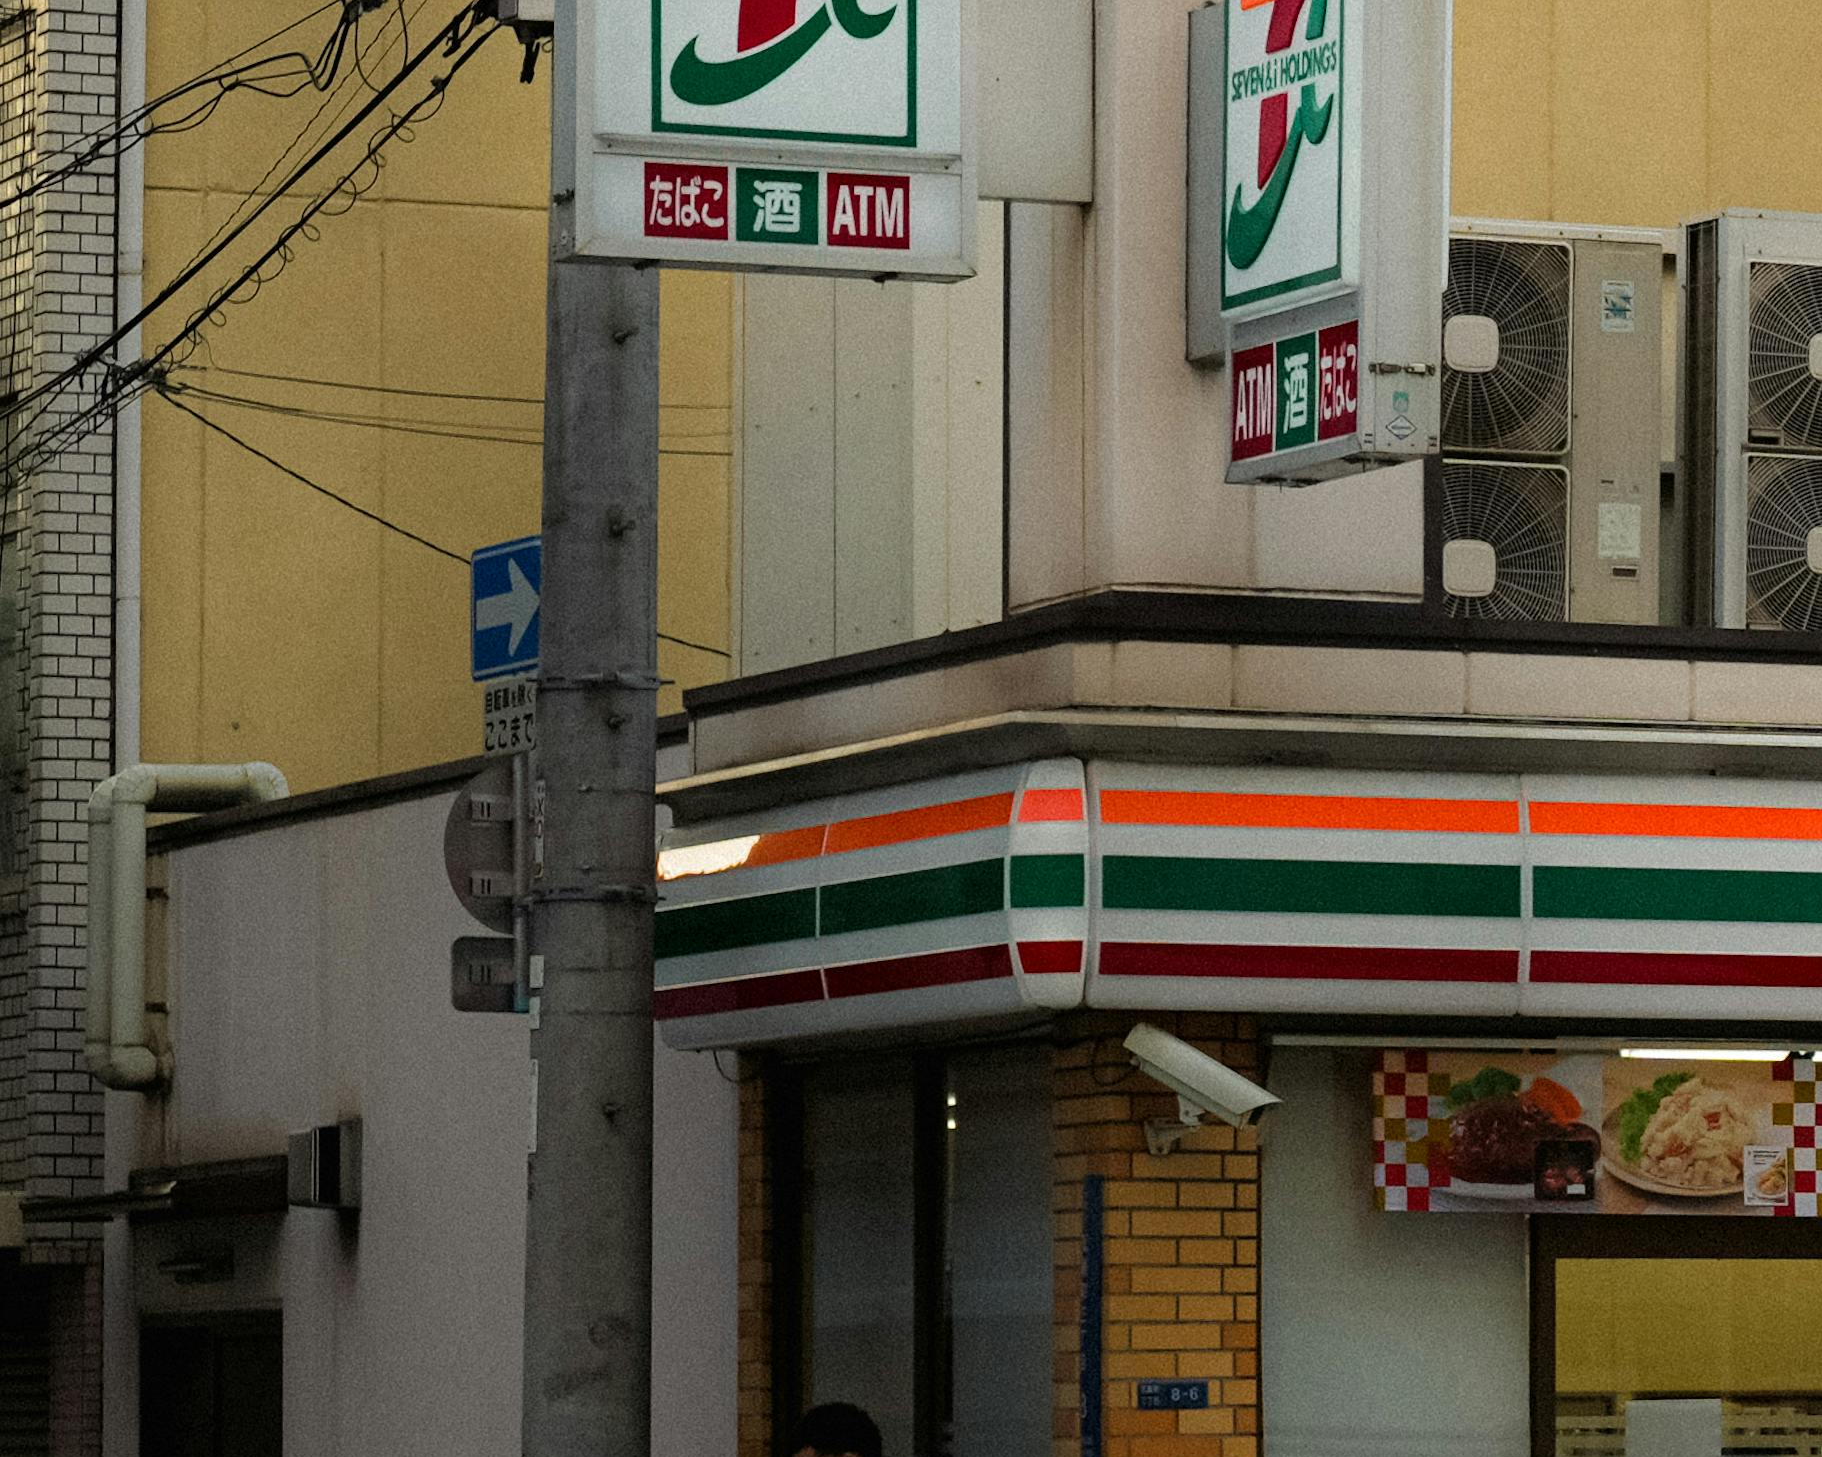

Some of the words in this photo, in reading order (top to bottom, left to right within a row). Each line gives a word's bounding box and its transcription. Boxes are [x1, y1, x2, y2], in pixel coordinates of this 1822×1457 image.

[1279, 41, 1337, 87] HOLDINGS
[649, 175, 725, 227] たばこ
[753, 180, 802, 233] 酒
[832, 184, 904, 239] ATM
[1235, 362, 1272, 443] ATM
[1283, 353, 1309, 434] 酒
[1320, 342, 1357, 422] たばこ
[485, 713, 533, 751] ここまで
[1170, 1386, 1200, 1403] 8-6
